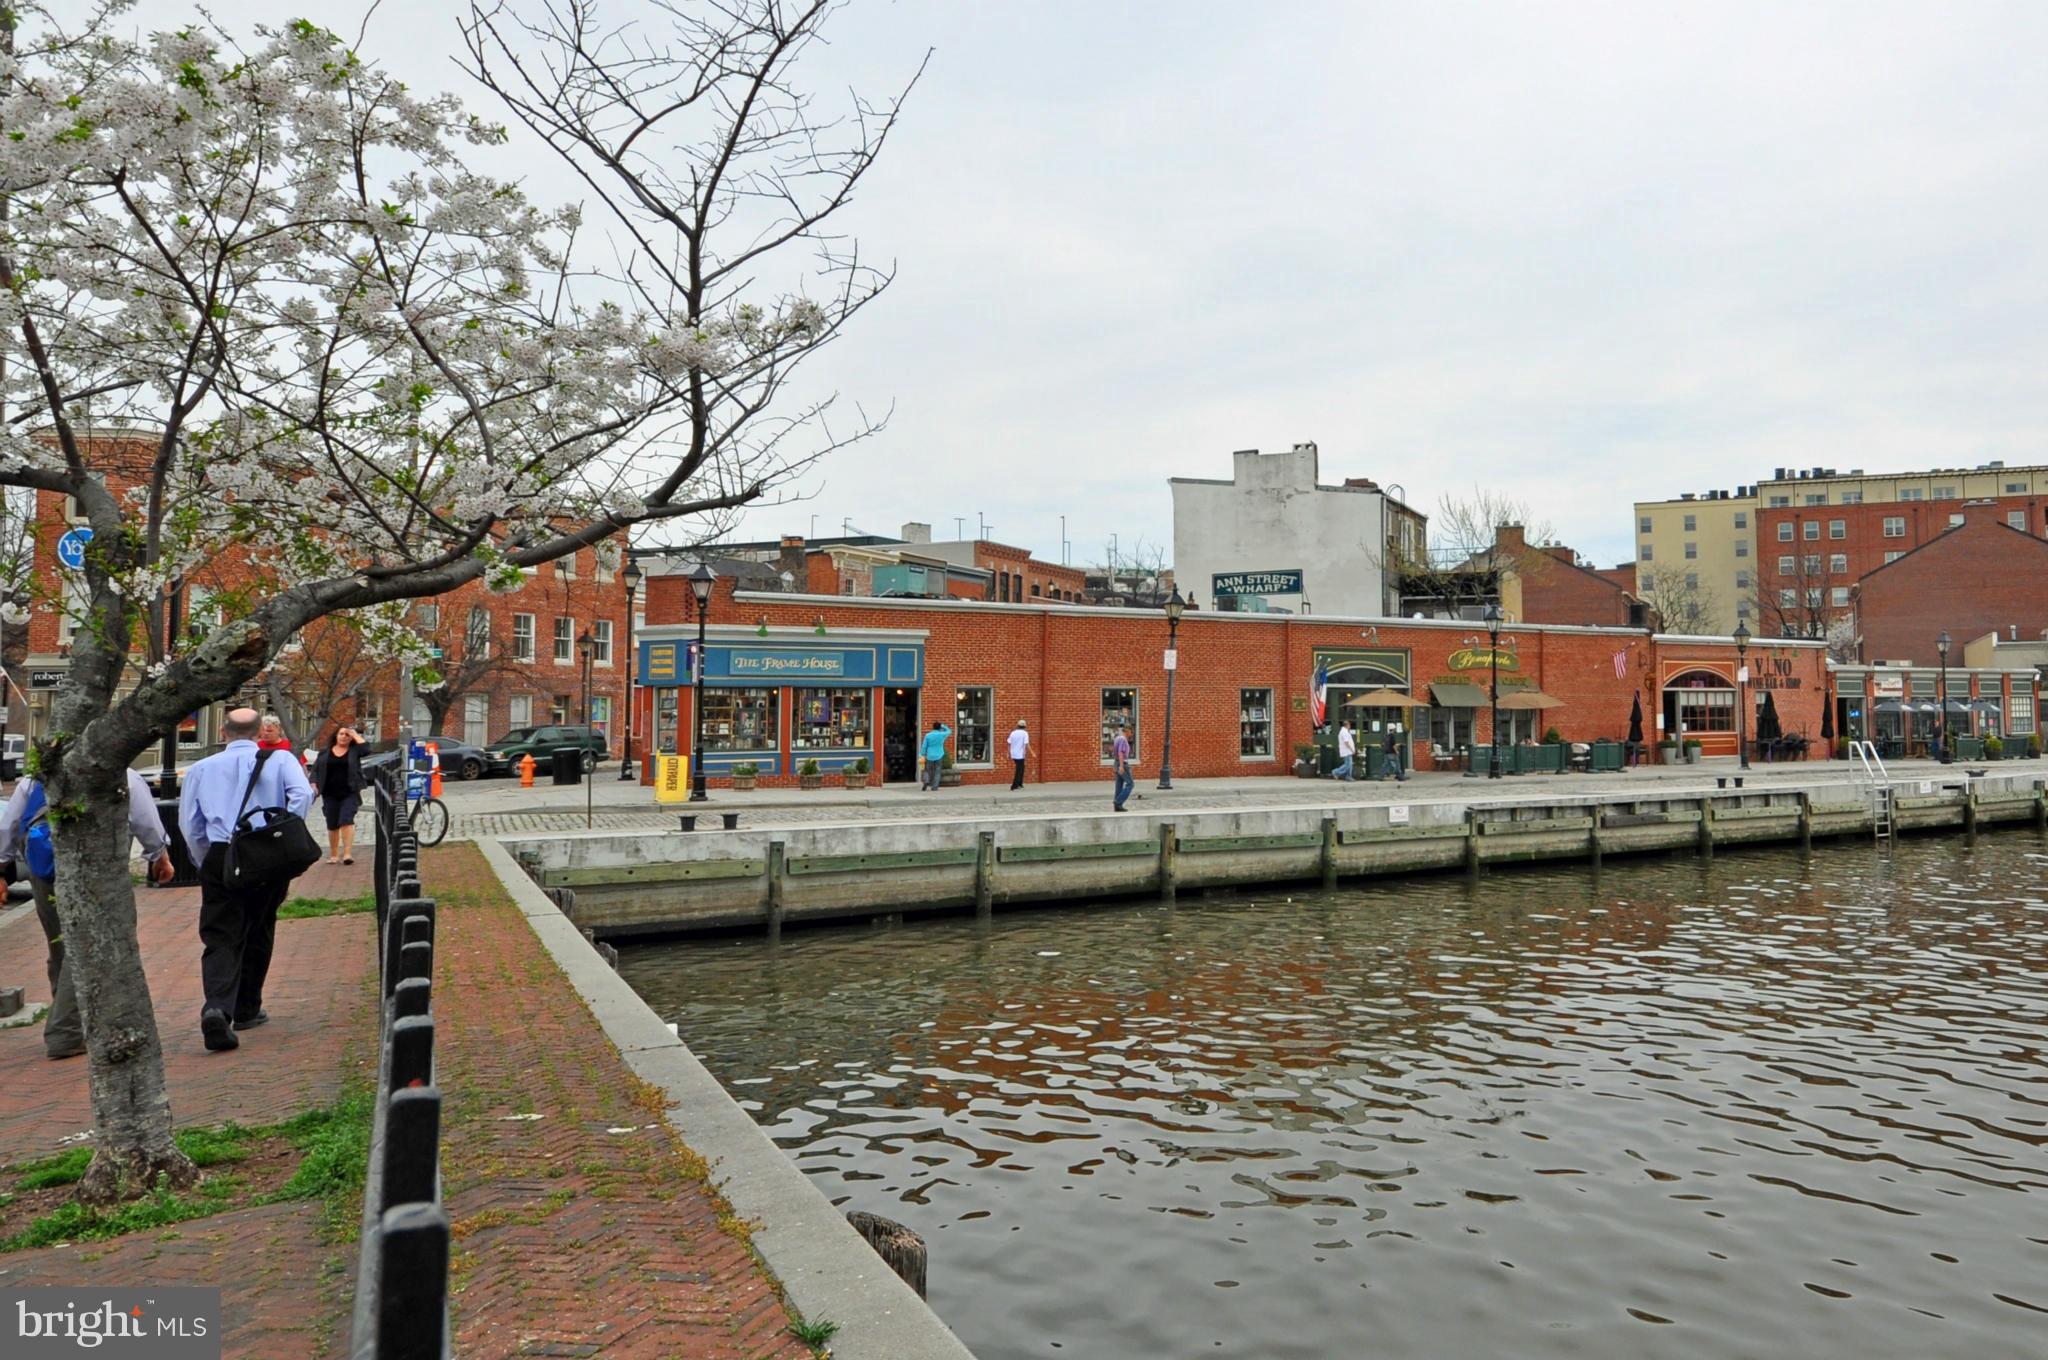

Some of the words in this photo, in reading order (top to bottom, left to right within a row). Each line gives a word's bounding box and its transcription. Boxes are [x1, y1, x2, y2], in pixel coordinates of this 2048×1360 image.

[1216, 575, 1244, 589] ANN
[1247, 574, 1297, 586] STREET
[1233, 583, 1281, 594] WHARF
[735, 657, 759, 668] THE
[761, 656, 801, 671] FRAME
[802, 656, 839, 670] HOUSE
[1755, 657, 1792, 676] VINO
